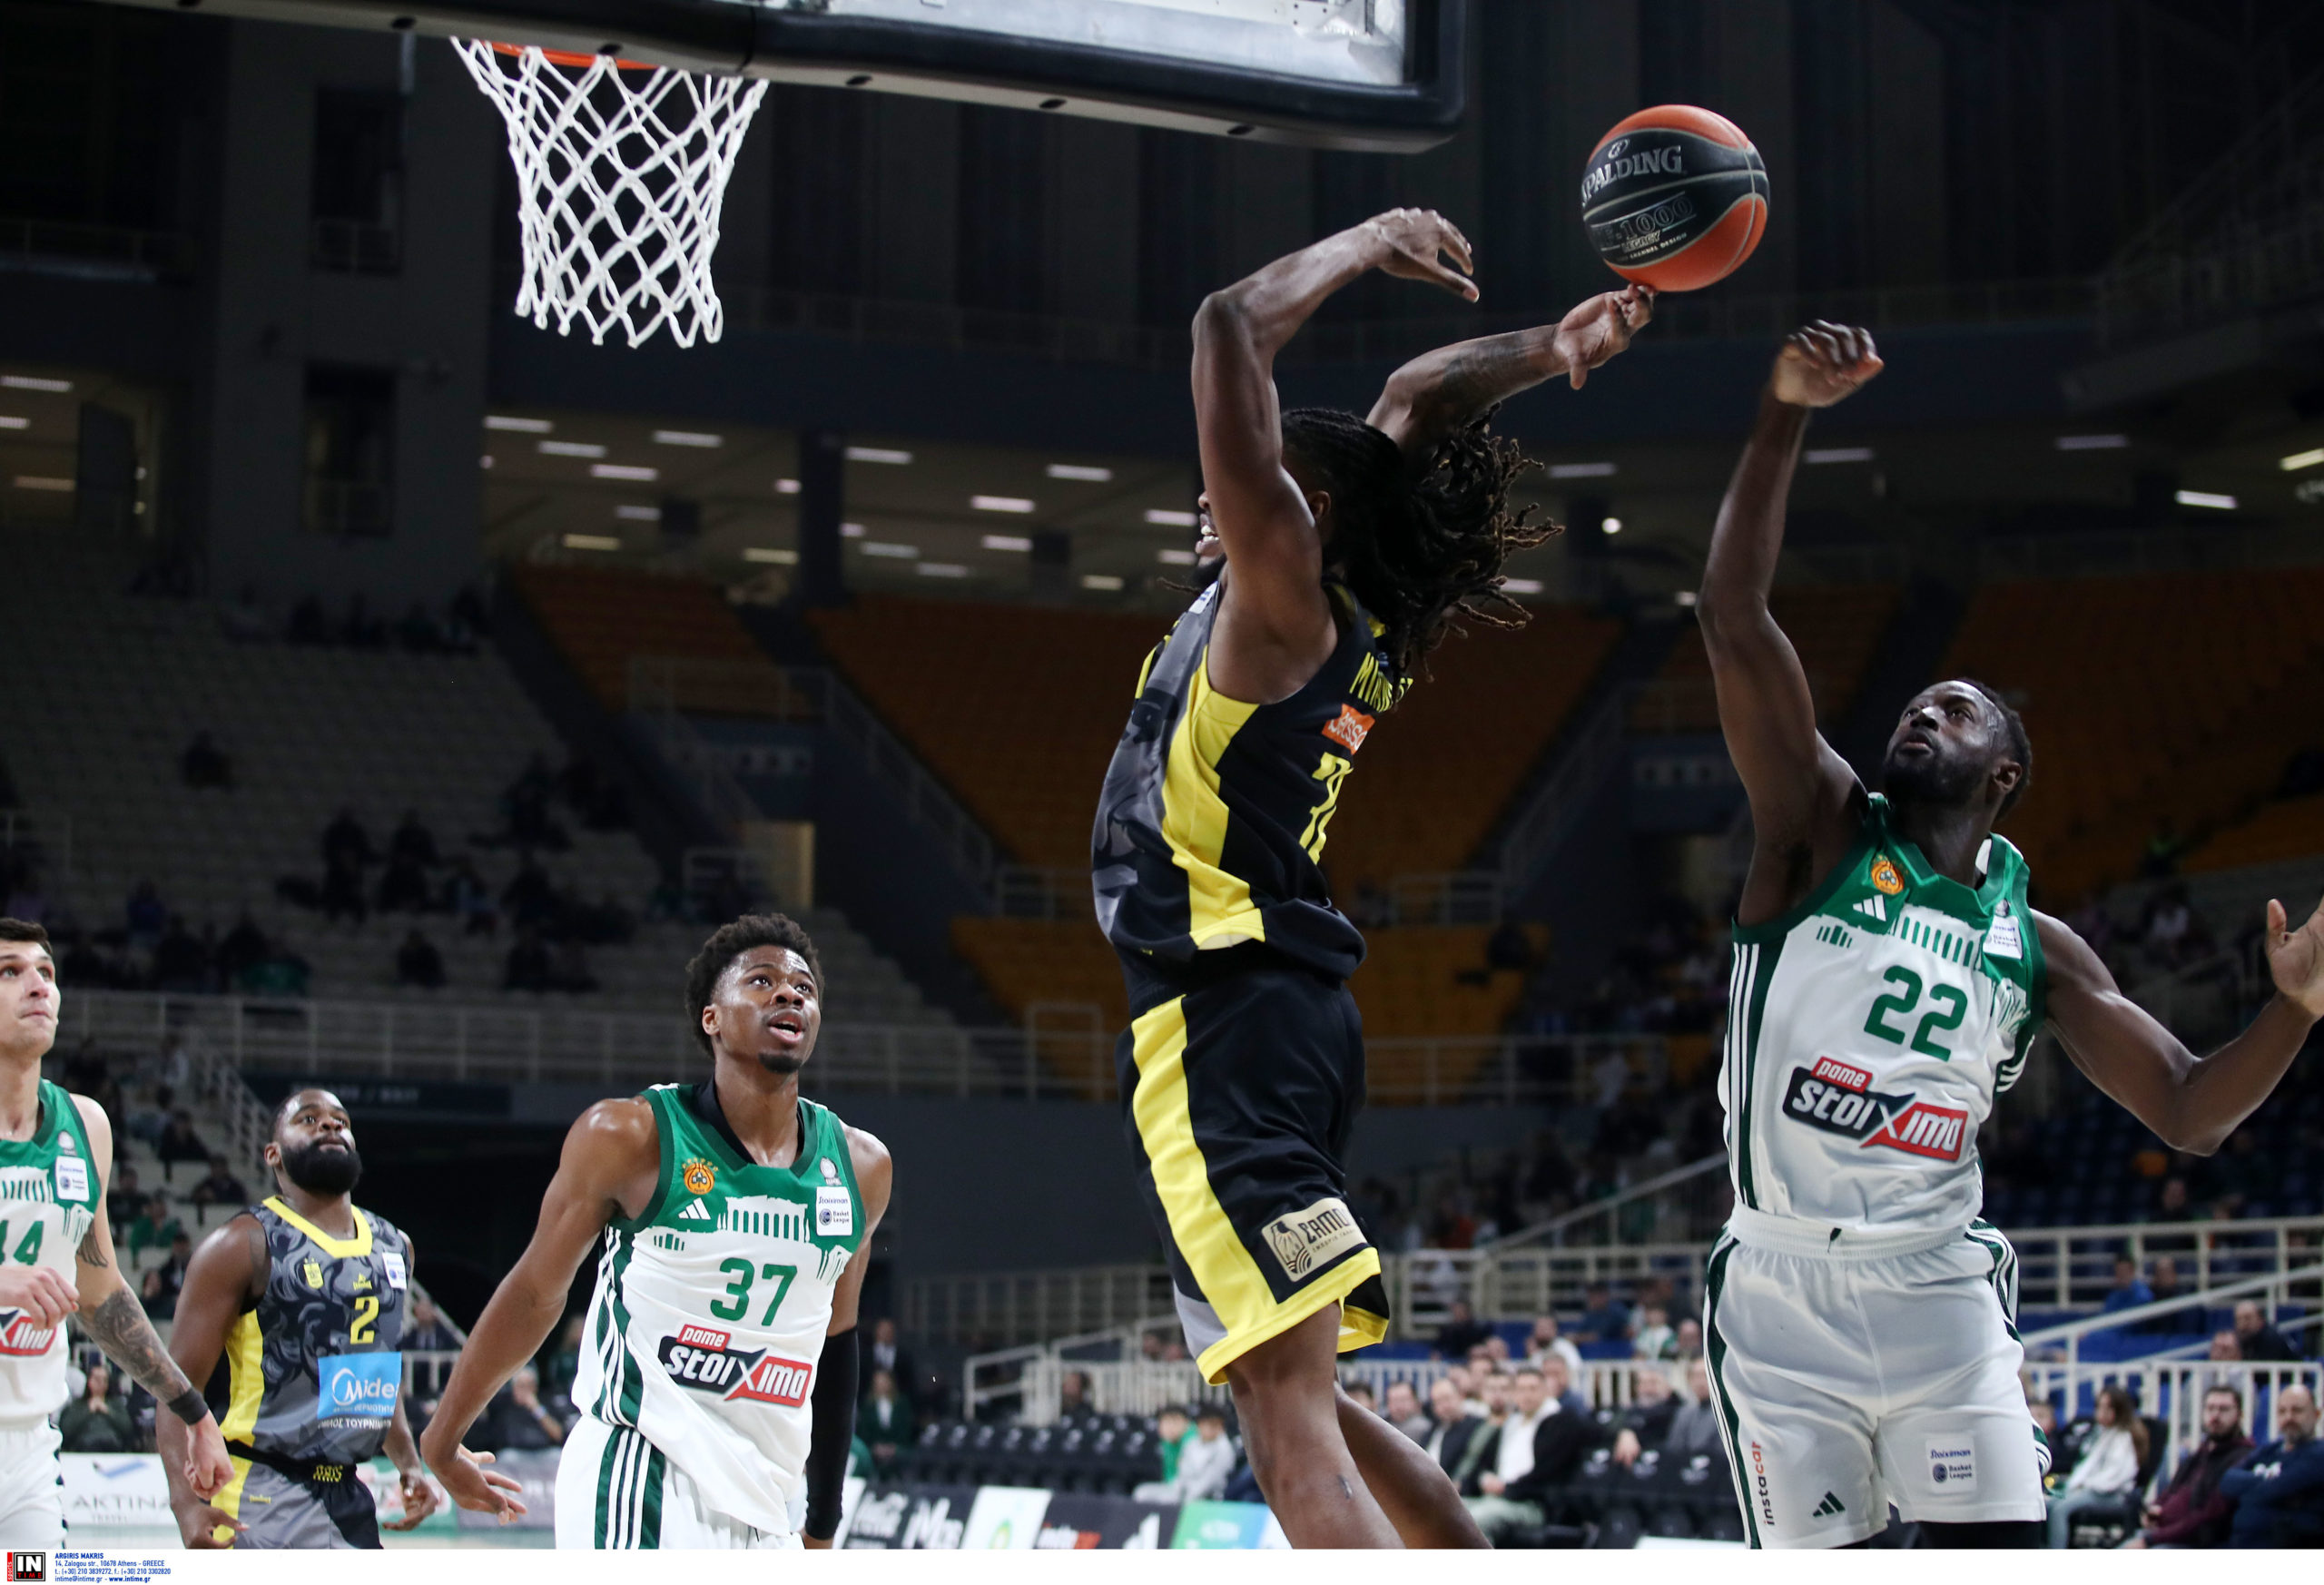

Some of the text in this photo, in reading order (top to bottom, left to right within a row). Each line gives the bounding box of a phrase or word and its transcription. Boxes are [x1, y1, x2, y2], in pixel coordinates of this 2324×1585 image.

[1581, 145, 1682, 208] SPALDING
[1864, 965, 1968, 1062] 22
[1816, 1060, 1866, 1088] pame
[350, 1295, 379, 1344] 2
[710, 1257, 798, 1326] 37
[682, 1328, 725, 1347] pame
[337, 1371, 399, 1404] Mide
[1751, 1441, 1776, 1526] instacar
